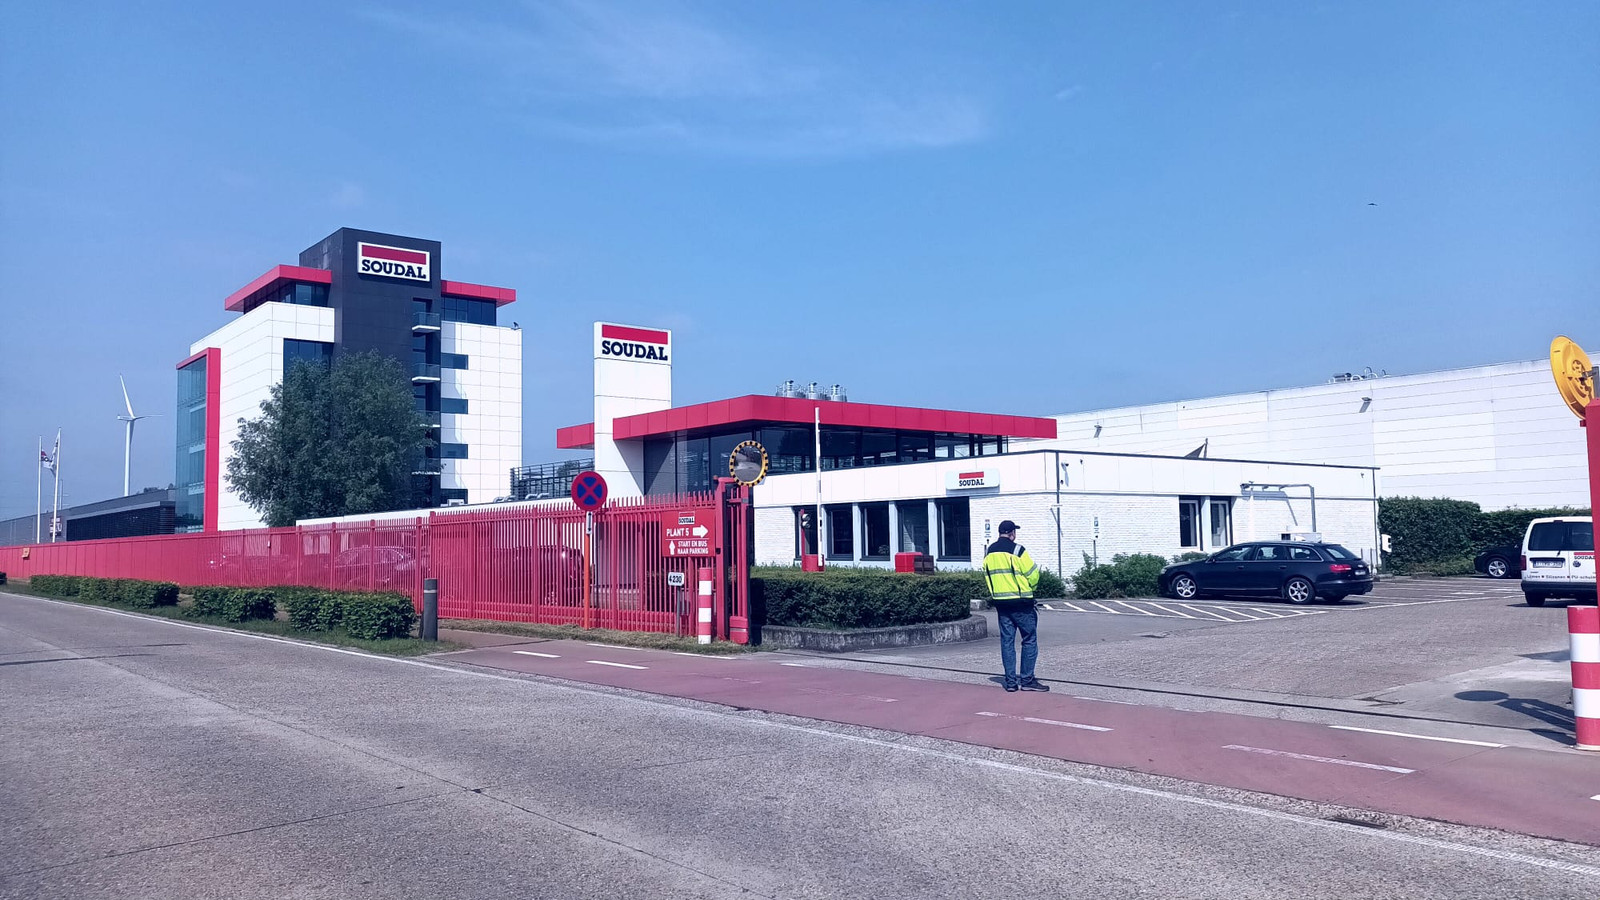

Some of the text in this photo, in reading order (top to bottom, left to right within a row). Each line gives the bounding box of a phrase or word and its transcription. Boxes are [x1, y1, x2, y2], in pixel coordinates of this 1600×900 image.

[361, 259, 427, 279] SOUDAL
[601, 340, 668, 361] SOUDAL
[958, 479, 985, 487] SOUDAL
[666, 528, 690, 537] PLANT 5
